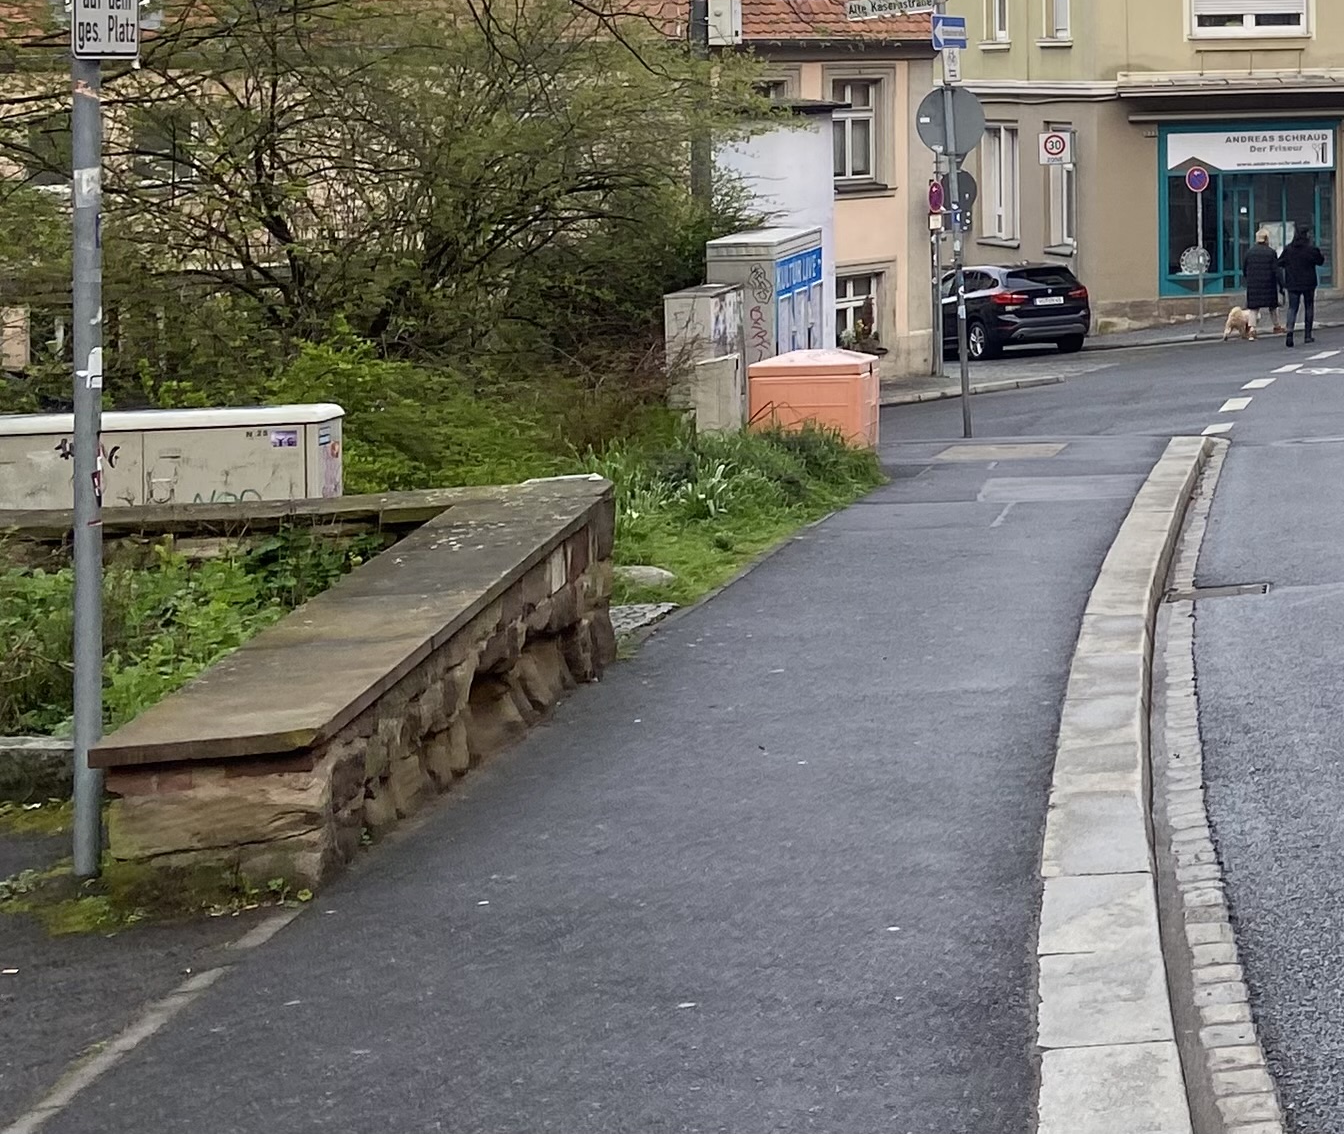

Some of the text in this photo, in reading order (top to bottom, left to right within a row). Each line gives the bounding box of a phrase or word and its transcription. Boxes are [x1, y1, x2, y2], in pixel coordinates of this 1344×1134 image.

[848, 3, 867, 15] Alte
[78, 15, 136, 50] ges. Platz
[1225, 133, 1328, 143] ANDREAS SCHRAUD
[1048, 139, 1062, 151] 30
[1249, 144, 1303, 153] Der Friseur
